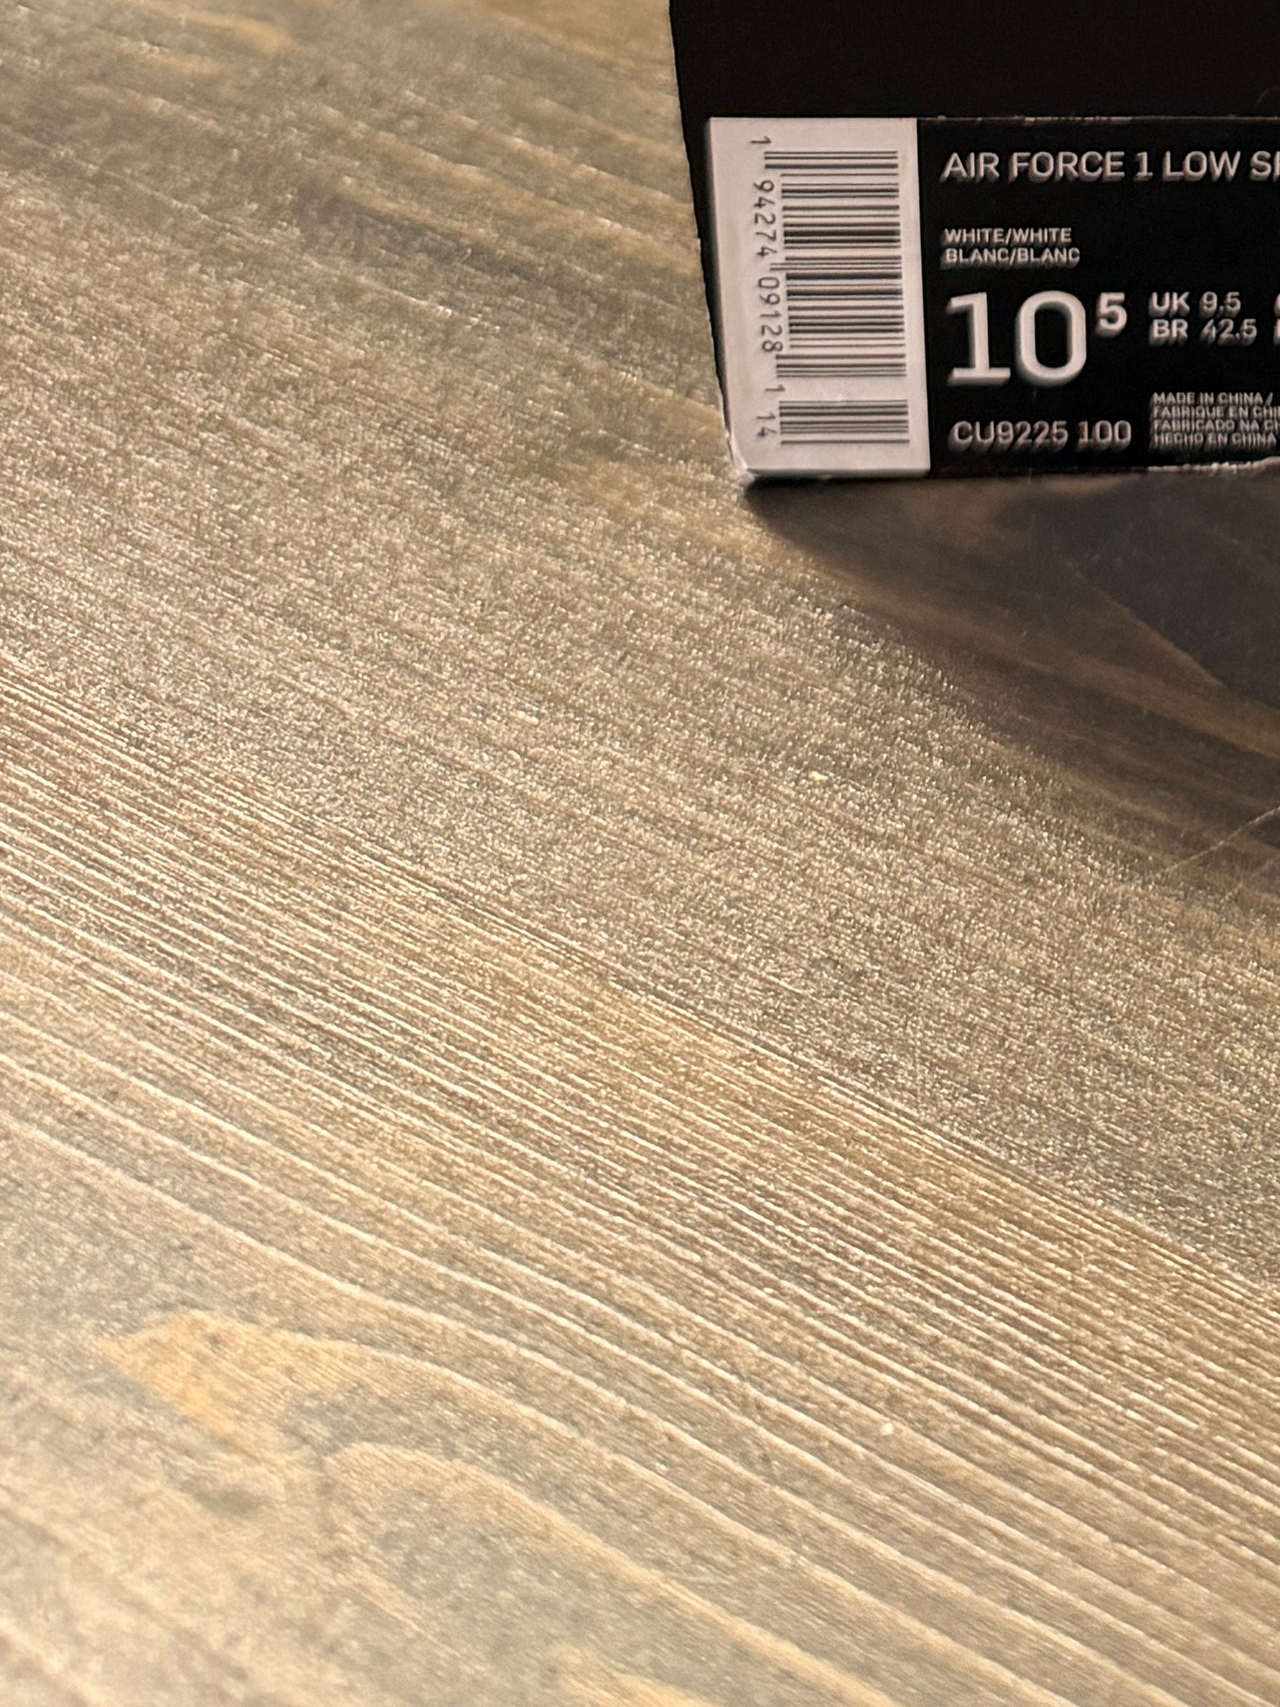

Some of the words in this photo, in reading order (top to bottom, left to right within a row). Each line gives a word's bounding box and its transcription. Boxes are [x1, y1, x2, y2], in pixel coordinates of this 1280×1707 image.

[943, 151, 1000, 180] AIR
[1008, 150, 1125, 180] FORCE
[1134, 150, 1153, 180] 1
[1162, 149, 1241, 179] LOW
[944, 227, 1072, 244] WHITE/WHITE
[943, 247, 1081, 266] BLANC/BLANC
[1150, 291, 1190, 317] UK
[1200, 291, 1242, 317] 9.5
[1150, 318, 1189, 345] BR
[1200, 318, 1258, 344] 42.5
[1151, 392, 1195, 405] MADE
[1199, 392, 1214, 405] IN
[1217, 392, 1263, 405] CHINA
[1152, 406, 1224, 419] FABRIQUE
[1228, 406, 1249, 419] EN
[1152, 419, 1235, 433] FABRICADO
[1239, 419, 1260, 433] NA
[950, 421, 1069, 451] CU9225
[1077, 421, 1132, 449] 100
[1152, 433, 1204, 446] HECHO
[1206, 433, 1227, 446] EN
[1231, 433, 1277, 446] CHINA
